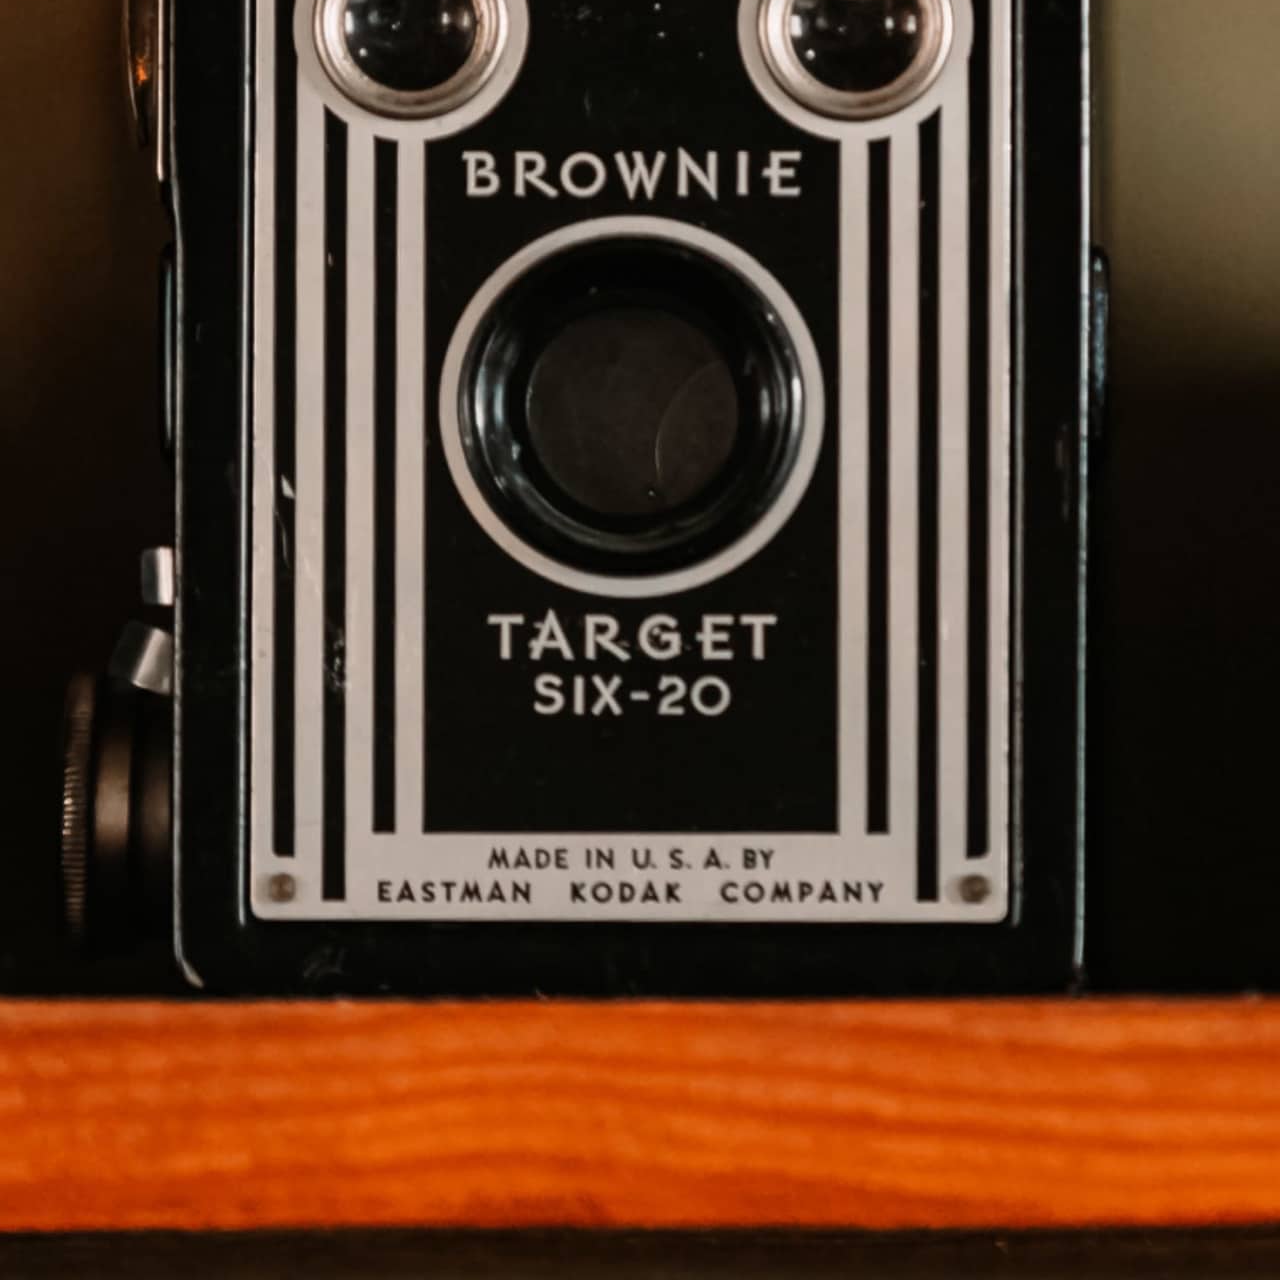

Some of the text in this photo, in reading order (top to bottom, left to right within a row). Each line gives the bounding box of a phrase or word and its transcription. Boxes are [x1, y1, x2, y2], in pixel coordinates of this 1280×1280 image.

[462, 146, 802, 201] BROWNIE
[487, 607, 778, 662] TARGET
[533, 673, 732, 716] SIX-20
[487, 847, 569, 871] MADE
[584, 847, 616, 871] IN
[742, 847, 775, 871] BY
[376, 879, 885, 904] EASTMAN KODAK COMPANY
